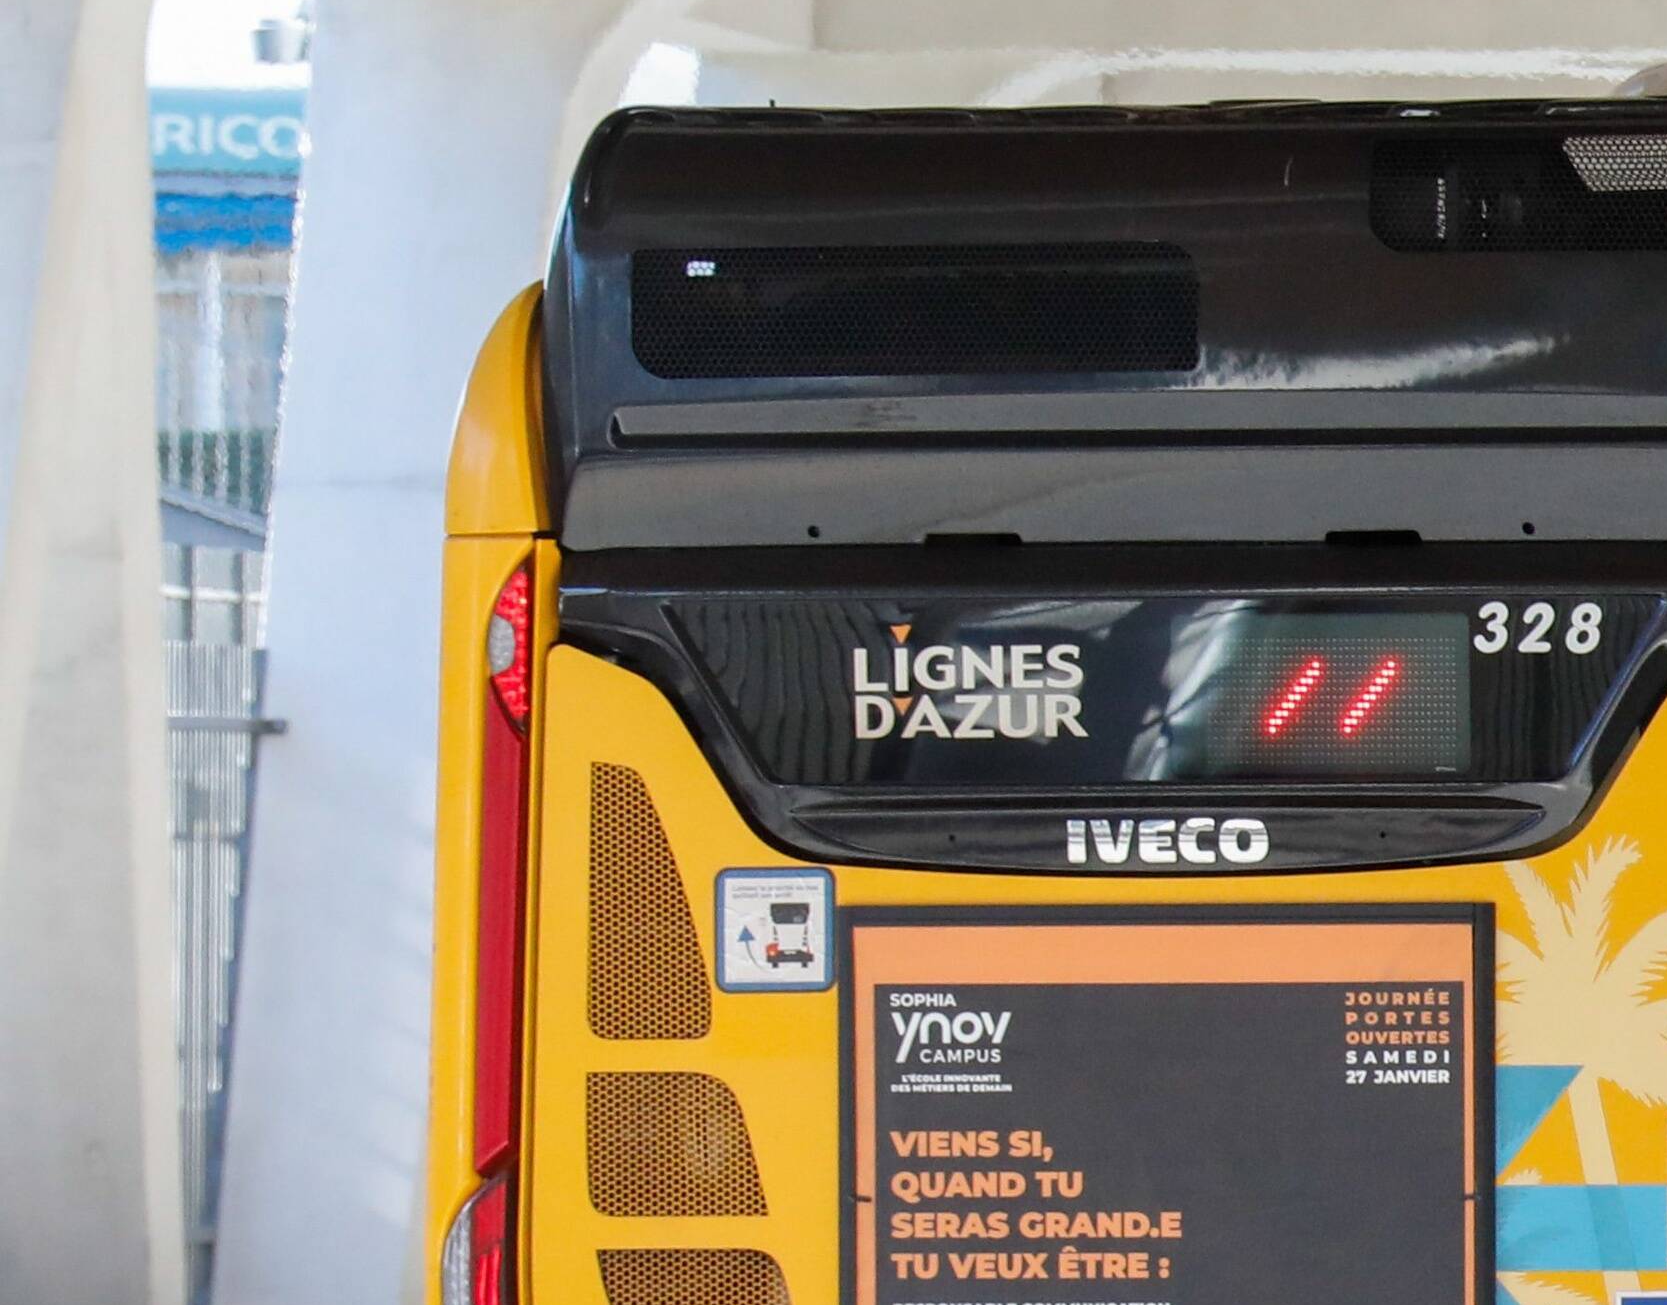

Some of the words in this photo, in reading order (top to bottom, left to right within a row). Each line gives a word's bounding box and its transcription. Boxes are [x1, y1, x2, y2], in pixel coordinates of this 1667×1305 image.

[1473, 601, 1602, 655] 328
[853, 626, 1084, 691] LIGNES
[1065, 817, 1270, 865] IVECO
[890, 993, 957, 1007] SOPHIA
[1345, 988, 1450, 1006] JOURNÉE
[1345, 1011, 1450, 1025] PORTES
[891, 1011, 1012, 1064] ynov
[1346, 1030, 1450, 1045] OUVERTES
[919, 1048, 1002, 1063] CAMPUS
[1345, 1049, 1450, 1064] SAMEDI
[943, 1074, 1001, 1083] INNOVANTE
[1345, 1069, 1367, 1085] 27
[1373, 1069, 1450, 1084] JANVIER
[890, 1084, 911, 1093] DES
[957, 1083, 971, 1093] DE
[972, 1083, 1013, 1092] DEMAIN
[890, 1130, 999, 1158] VIENS
[1008, 1130, 1054, 1162] SI,
[890, 1171, 1026, 1203] QUAND
[1035, 1171, 1083, 1197] TU
[890, 1211, 1010, 1239] SERAS
[1018, 1211, 1183, 1239] GRAND.E
[890, 1252, 939, 1280] TU
[948, 1252, 1048, 1280] VEUX
[1058, 1245, 1150, 1280] ÊTRE
